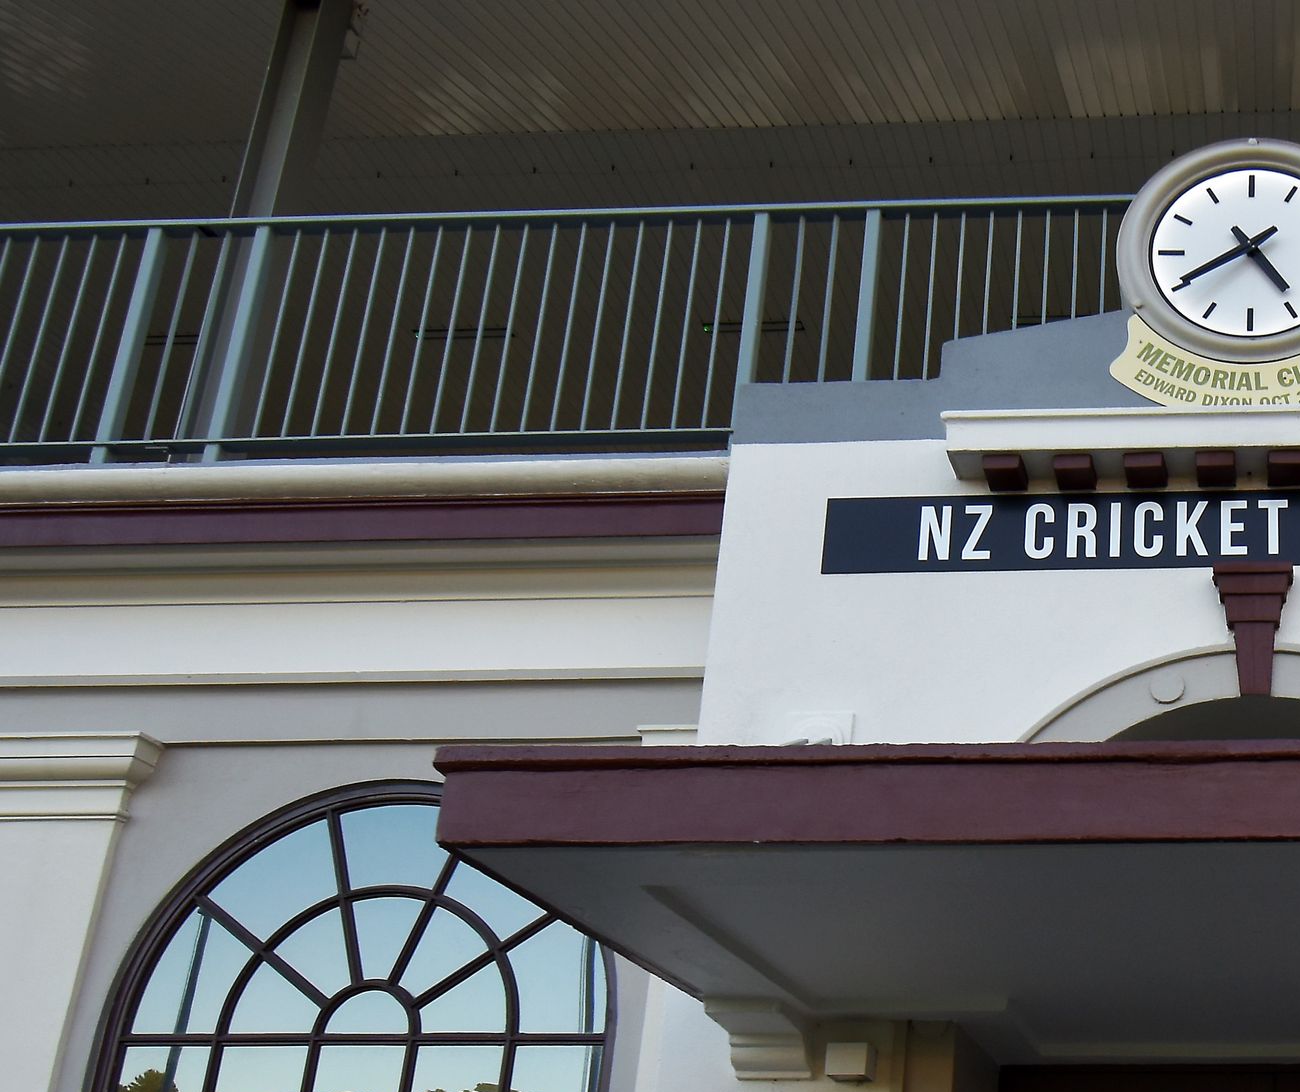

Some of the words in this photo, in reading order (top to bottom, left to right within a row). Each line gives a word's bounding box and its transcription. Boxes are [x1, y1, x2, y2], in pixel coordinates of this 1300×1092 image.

[1134, 368, 1197, 403] EDWARD
[1136, 342, 1269, 391] MEMORIAL
[917, 504, 993, 561] NZ
[1024, 499, 1289, 560] CRICKET
